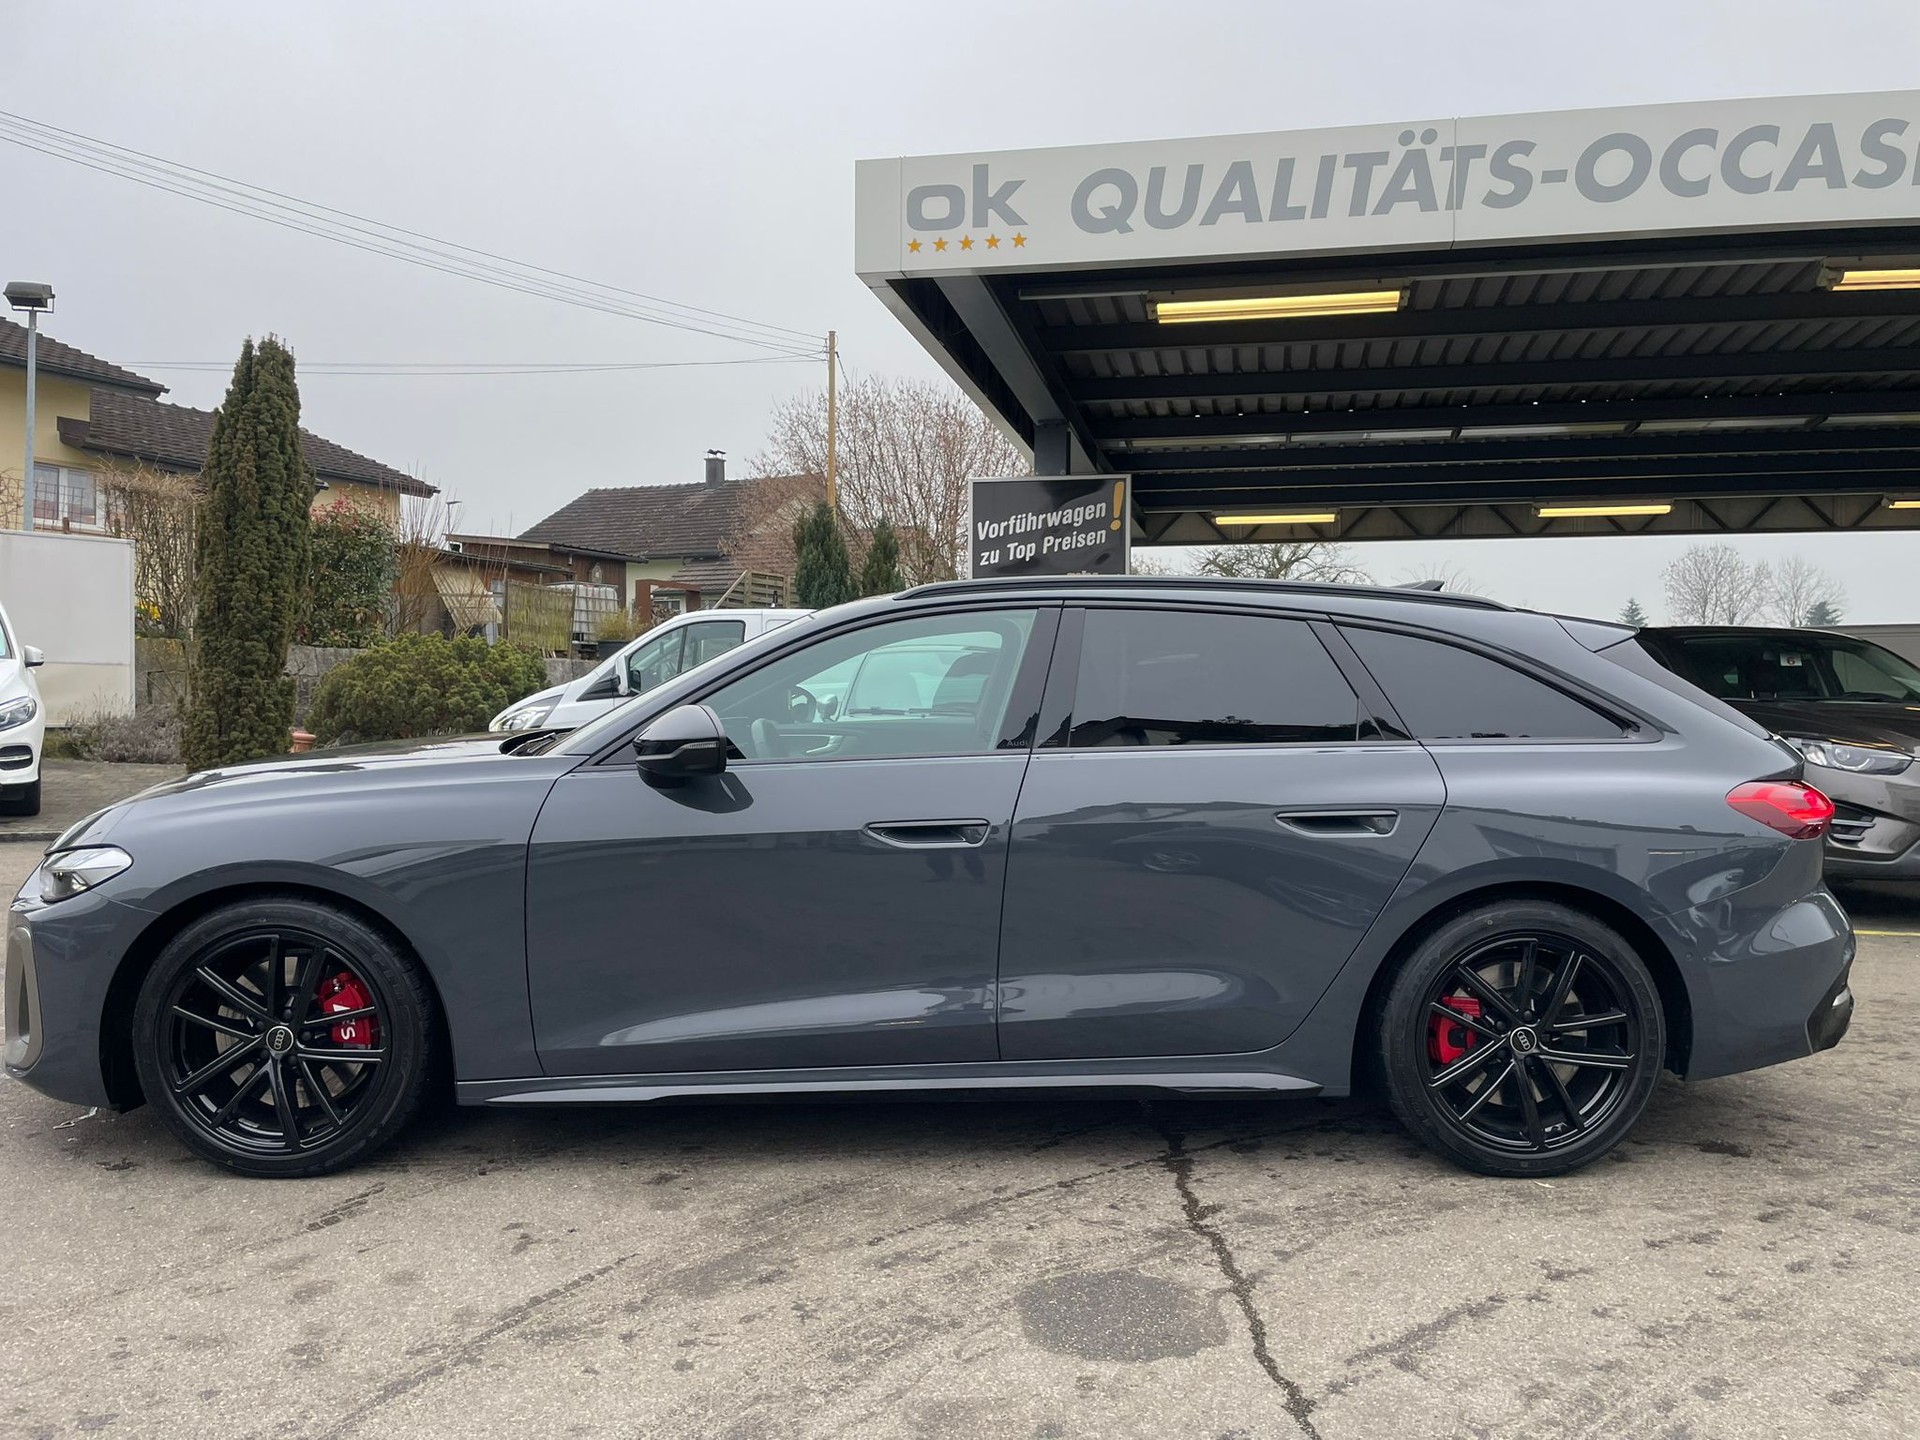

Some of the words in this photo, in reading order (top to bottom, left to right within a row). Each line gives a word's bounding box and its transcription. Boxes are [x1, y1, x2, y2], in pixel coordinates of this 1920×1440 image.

[906, 163, 1029, 232] ok
[977, 502, 1107, 541] Vorführwagen
[979, 549, 1000, 566] zu
[1006, 542, 1036, 562] Top
[1042, 529, 1107, 555] Preisen
[1007, 739, 1029, 747] Audi
